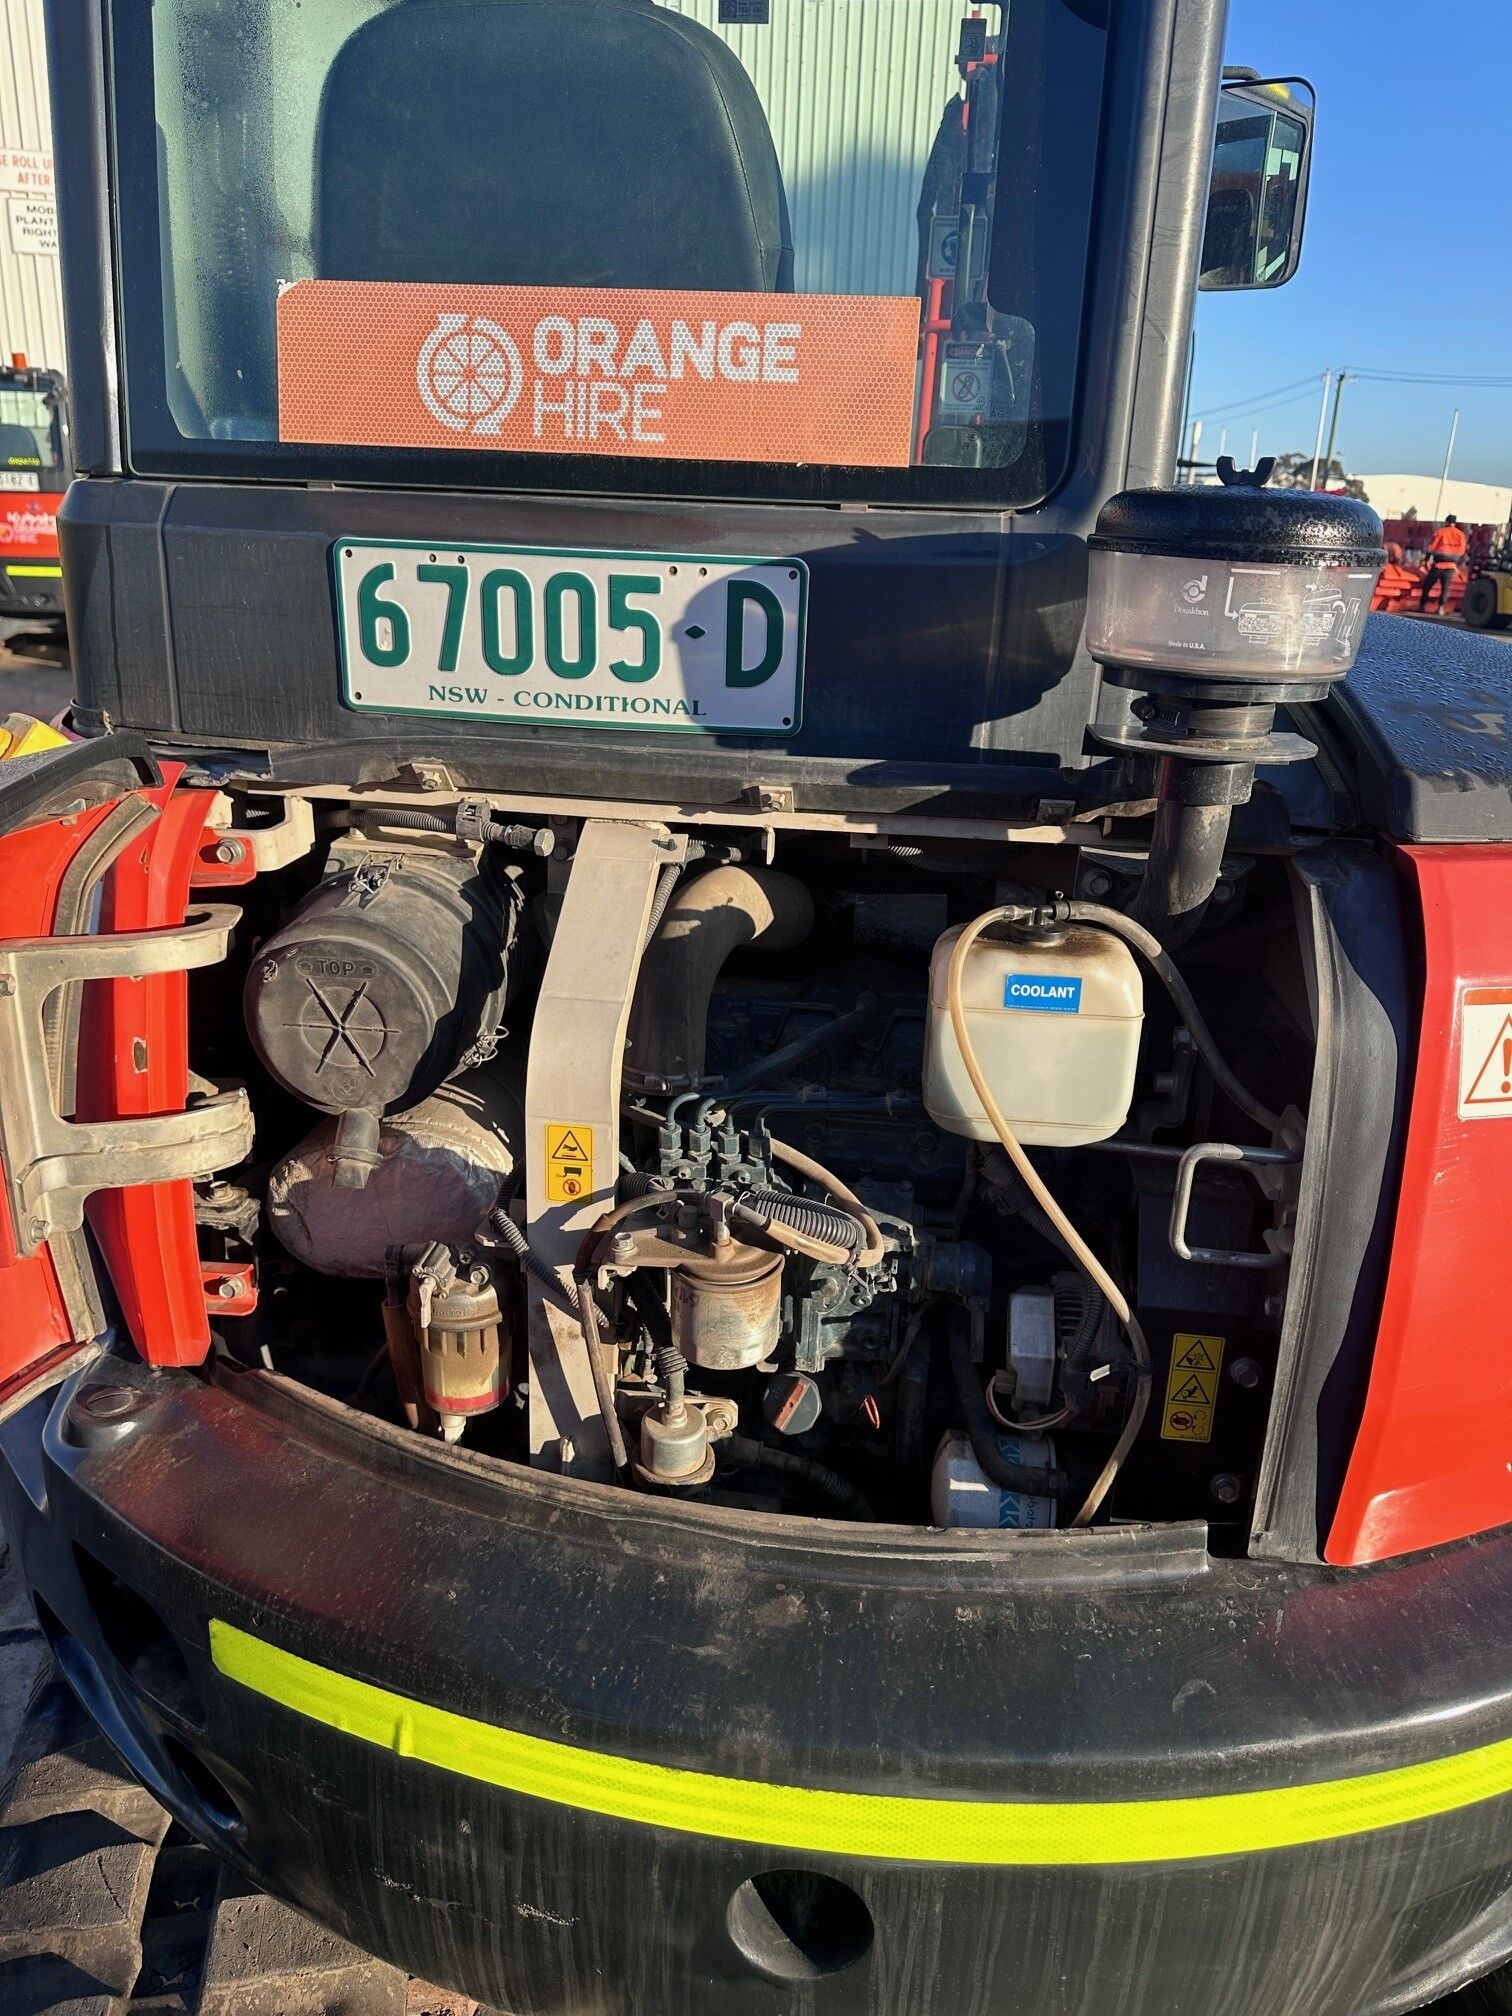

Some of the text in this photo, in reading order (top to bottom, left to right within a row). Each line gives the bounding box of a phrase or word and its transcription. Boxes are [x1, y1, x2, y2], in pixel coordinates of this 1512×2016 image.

[12, 155, 38, 169] ROLL
[18, 172, 50, 186] AFTER
[533, 314, 803, 384] ORANGE
[533, 379, 669, 443] HIRE
[358, 562, 663, 684] 67005
[428, 685, 488, 704] NSW
[513, 690, 707, 716] CONDITIONAL
[318, 959, 355, 975] TOP
[1010, 983, 1076, 999] COOLANT
